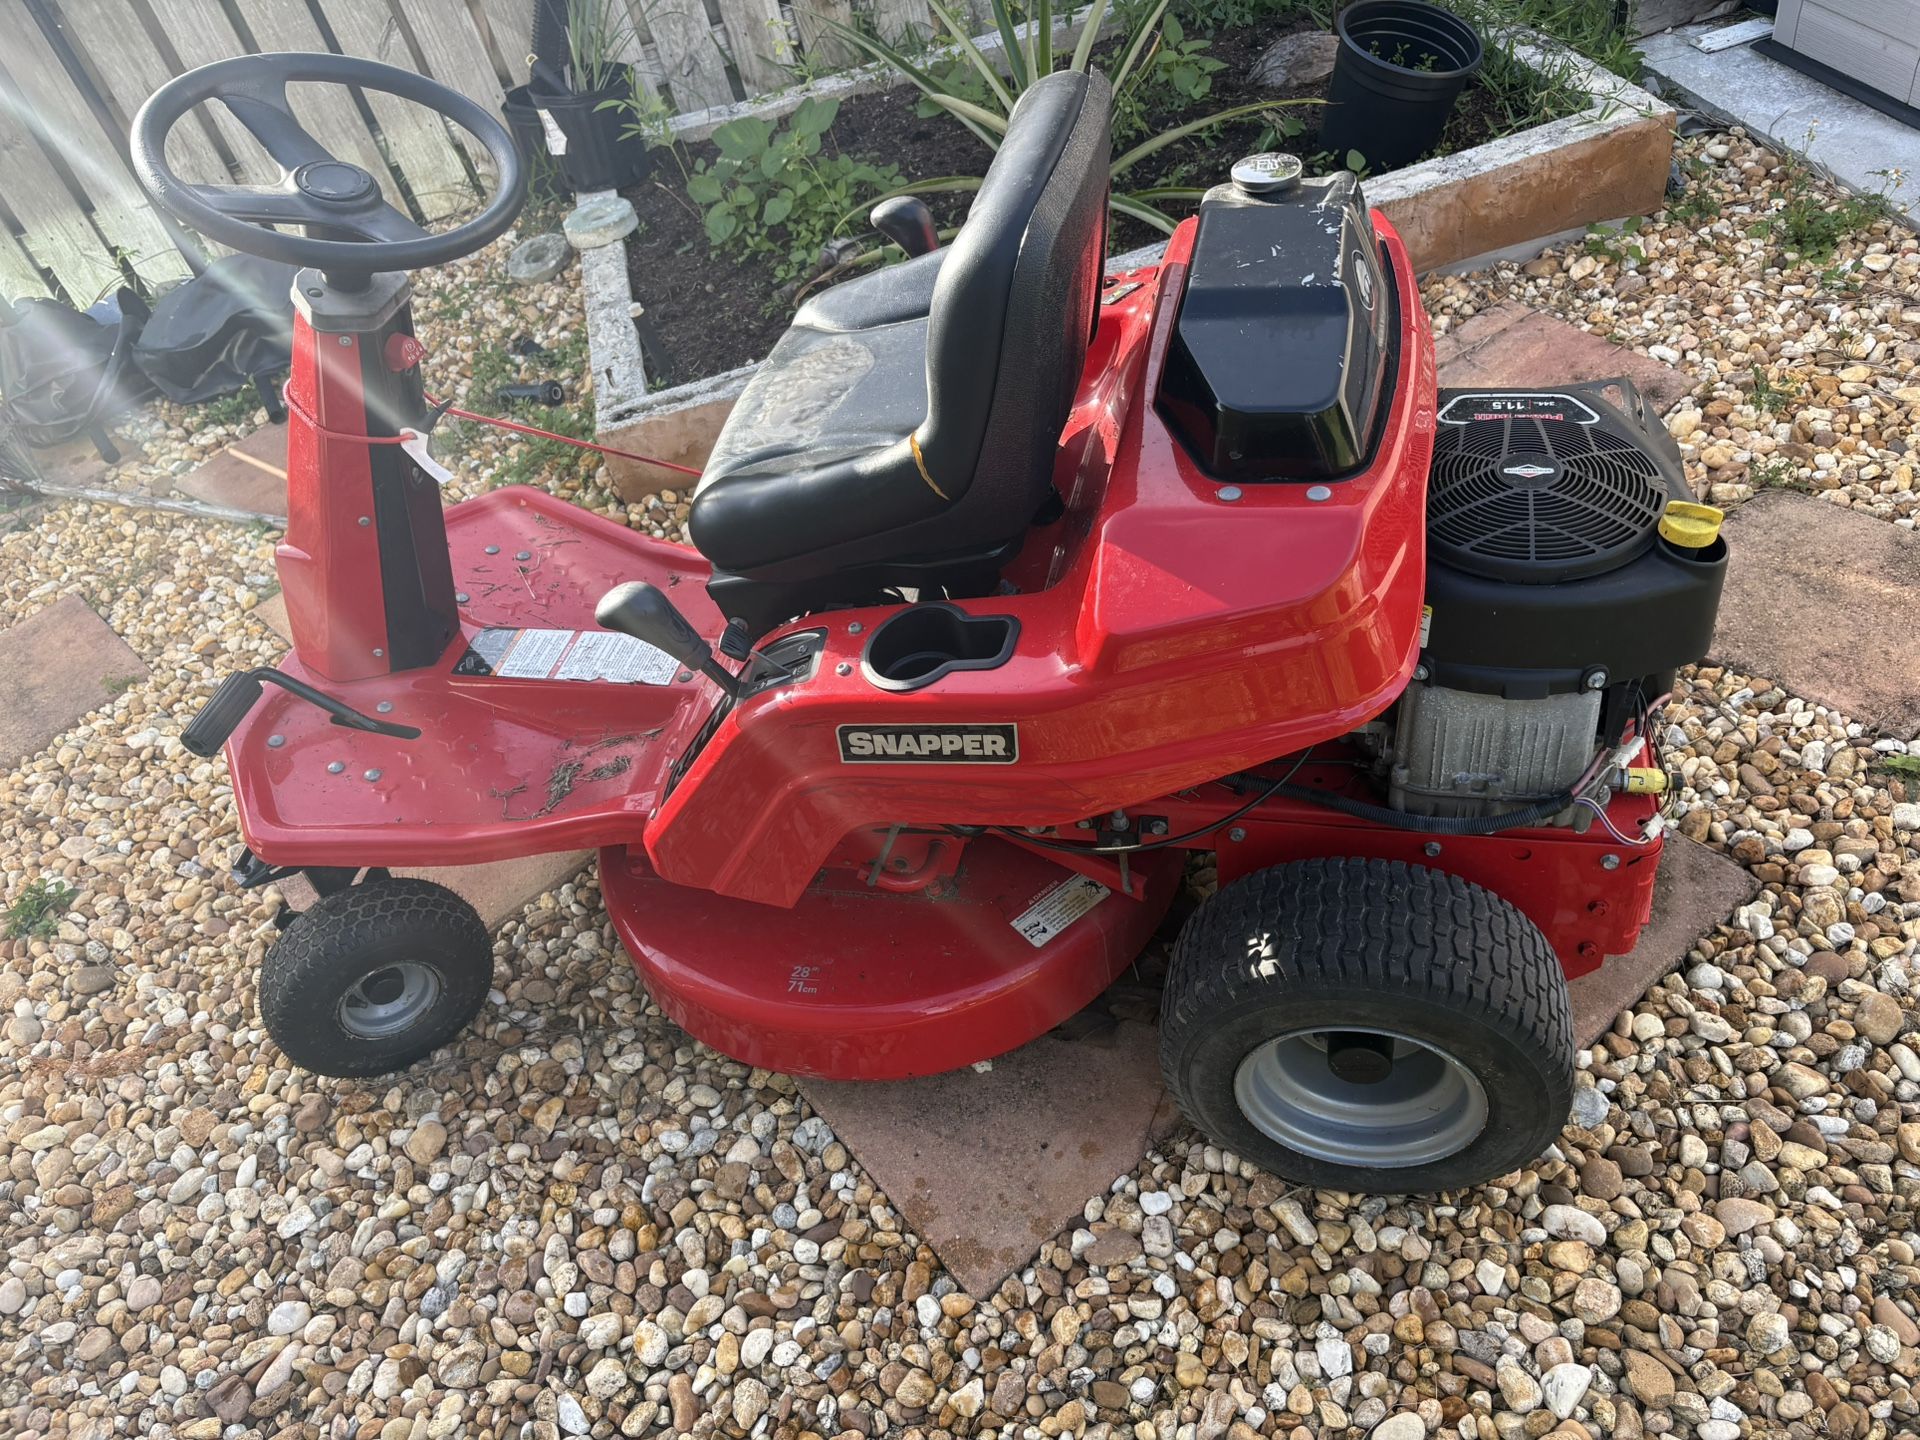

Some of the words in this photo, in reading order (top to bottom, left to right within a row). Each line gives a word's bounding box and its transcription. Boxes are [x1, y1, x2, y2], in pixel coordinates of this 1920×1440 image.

[1492, 401, 1525, 410] 11.5
[847, 732, 1007, 756] SNAPPER
[787, 981, 818, 994] 71cm
